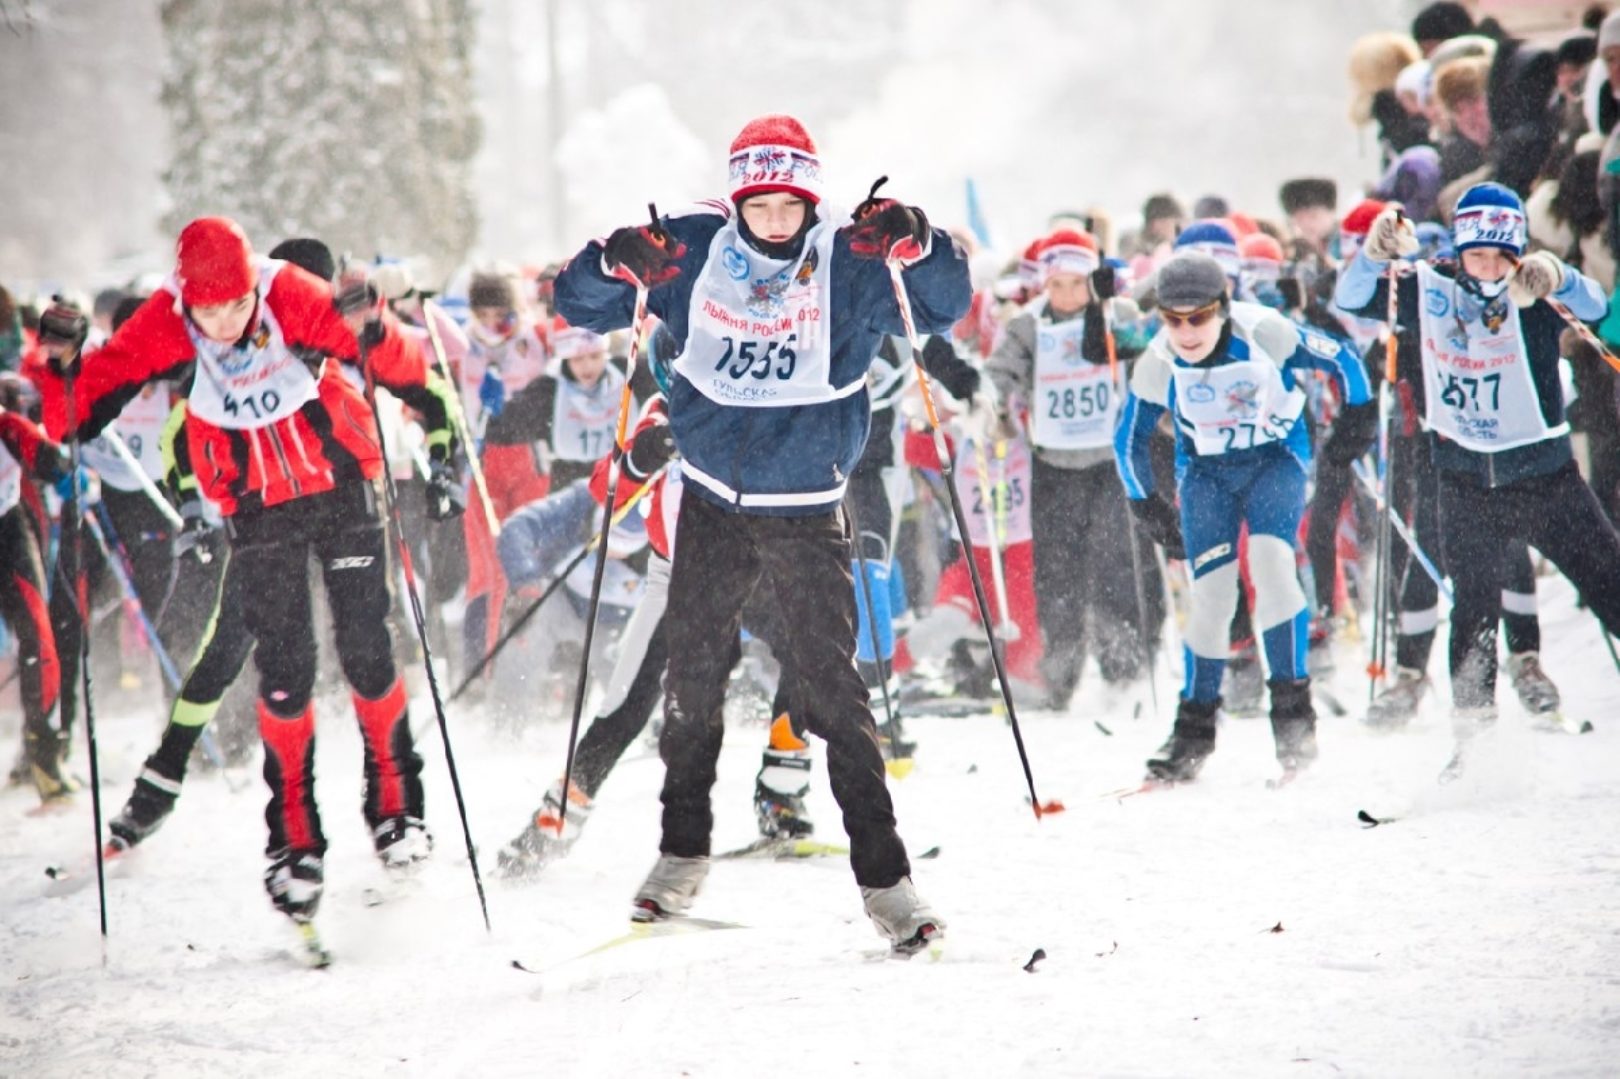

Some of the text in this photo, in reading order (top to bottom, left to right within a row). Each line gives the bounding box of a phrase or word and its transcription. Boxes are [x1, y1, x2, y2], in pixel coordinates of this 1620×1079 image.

[742, 170, 795, 185] 2012
[1475, 228, 1514, 241] 2012
[703, 300, 749, 331] ЛЫЖНЯ
[796, 307, 821, 322] 012
[714, 333, 797, 380] 7555
[1047, 382, 1109, 419] 2850
